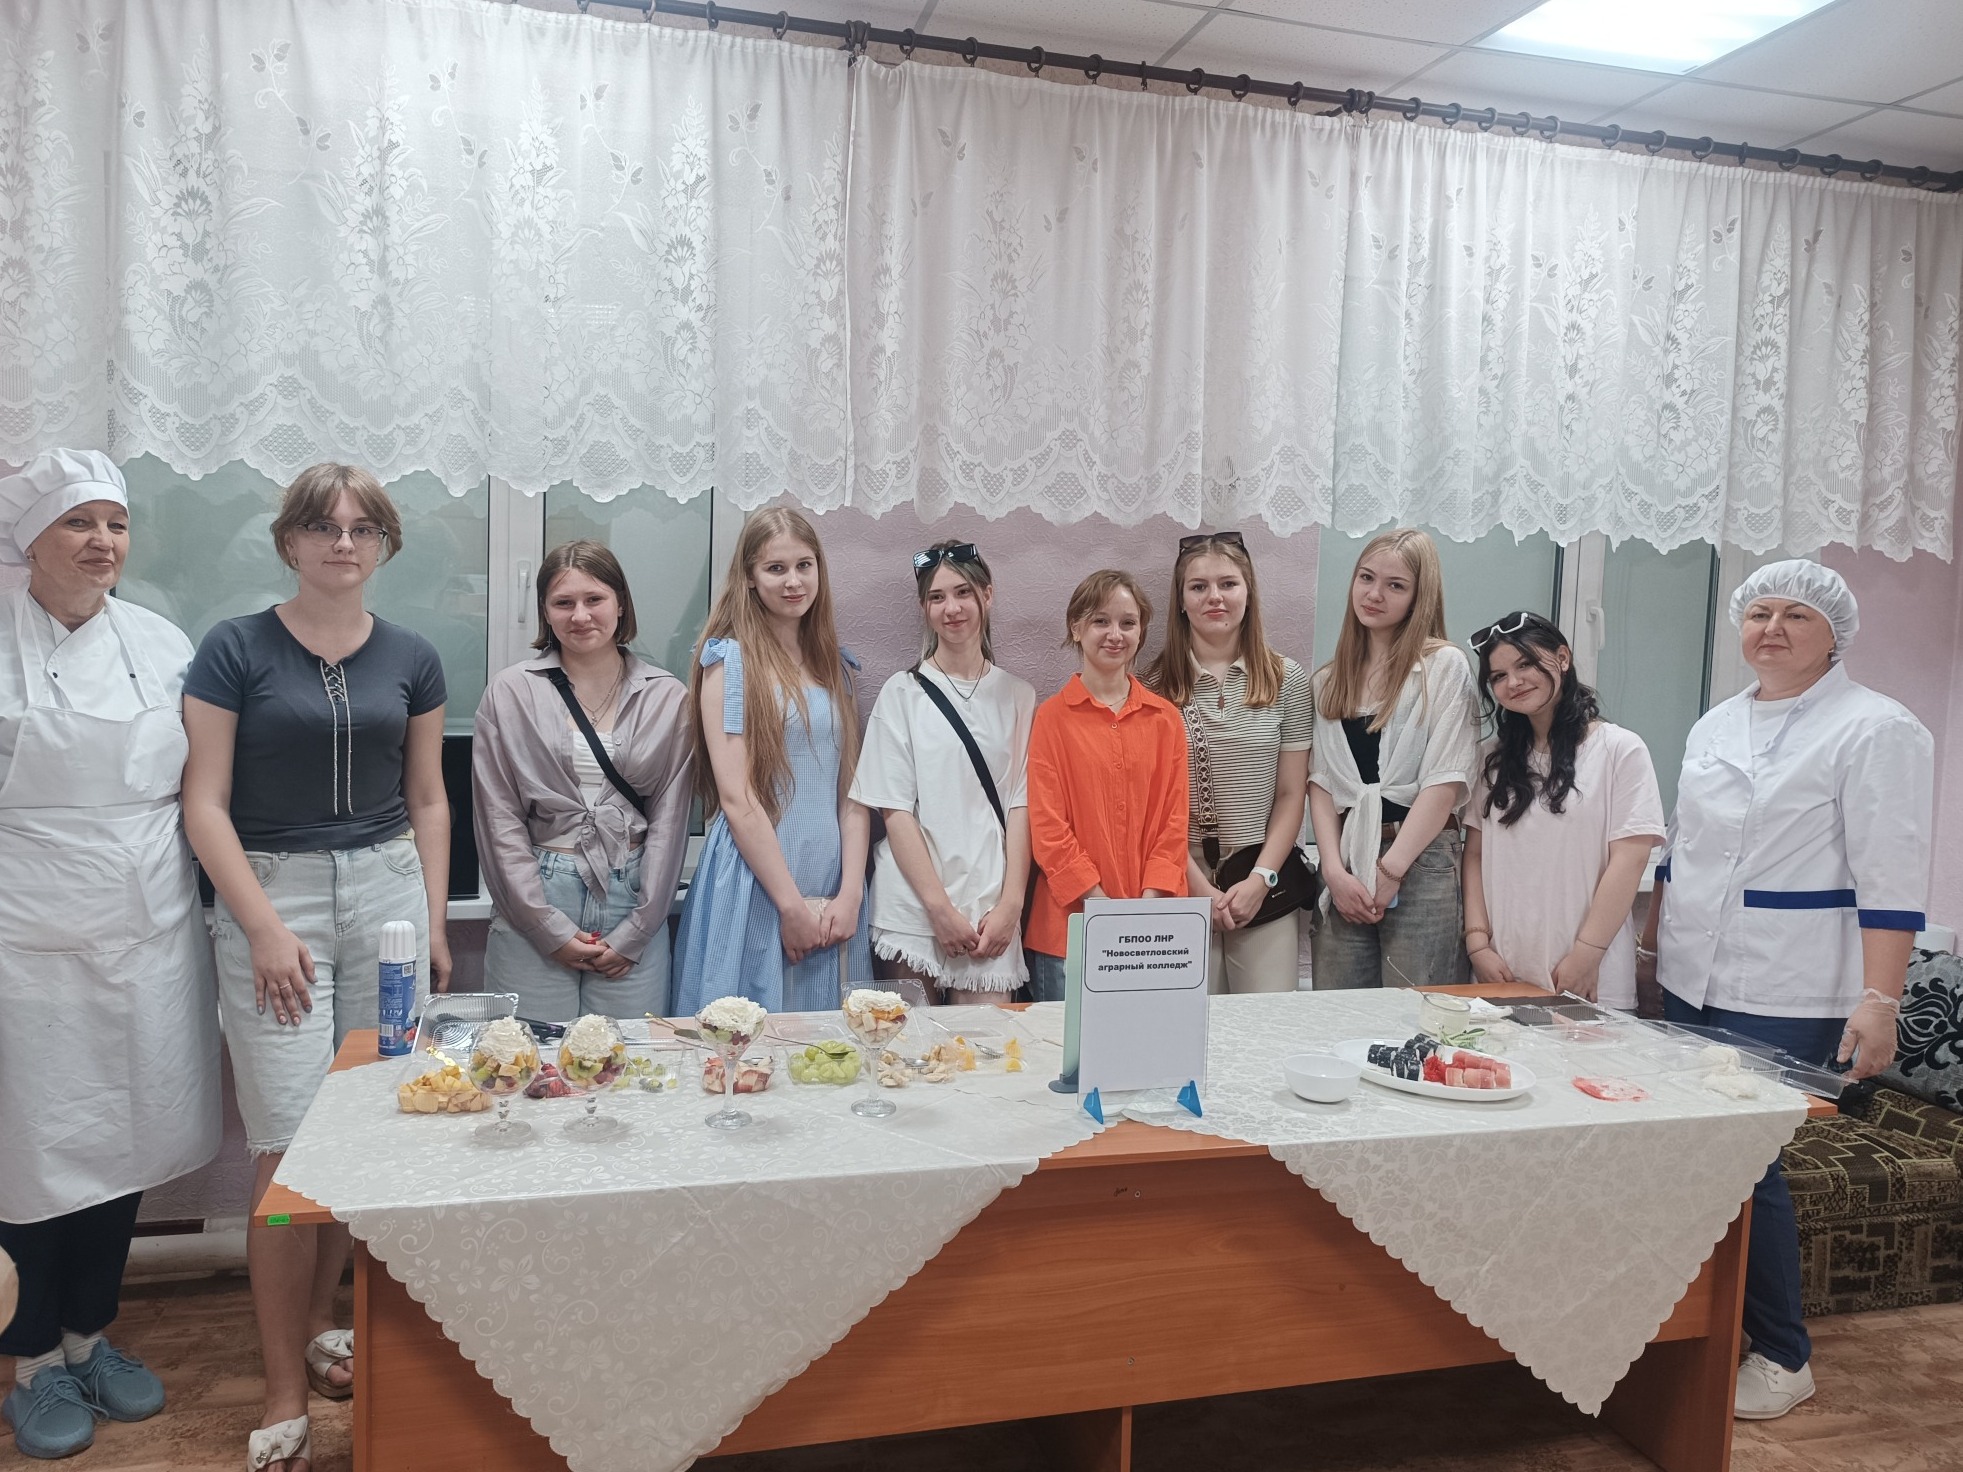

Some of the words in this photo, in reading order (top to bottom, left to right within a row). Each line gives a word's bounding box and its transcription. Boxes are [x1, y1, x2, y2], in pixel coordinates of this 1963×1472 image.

[1118, 935, 1152, 943] ГБПОО
[1153, 934, 1174, 943] ЛНР
[1102, 948, 1189, 957] "Новосветловский
[1098, 962, 1144, 972] аграрный
[1147, 961, 1192, 970] колледж"
